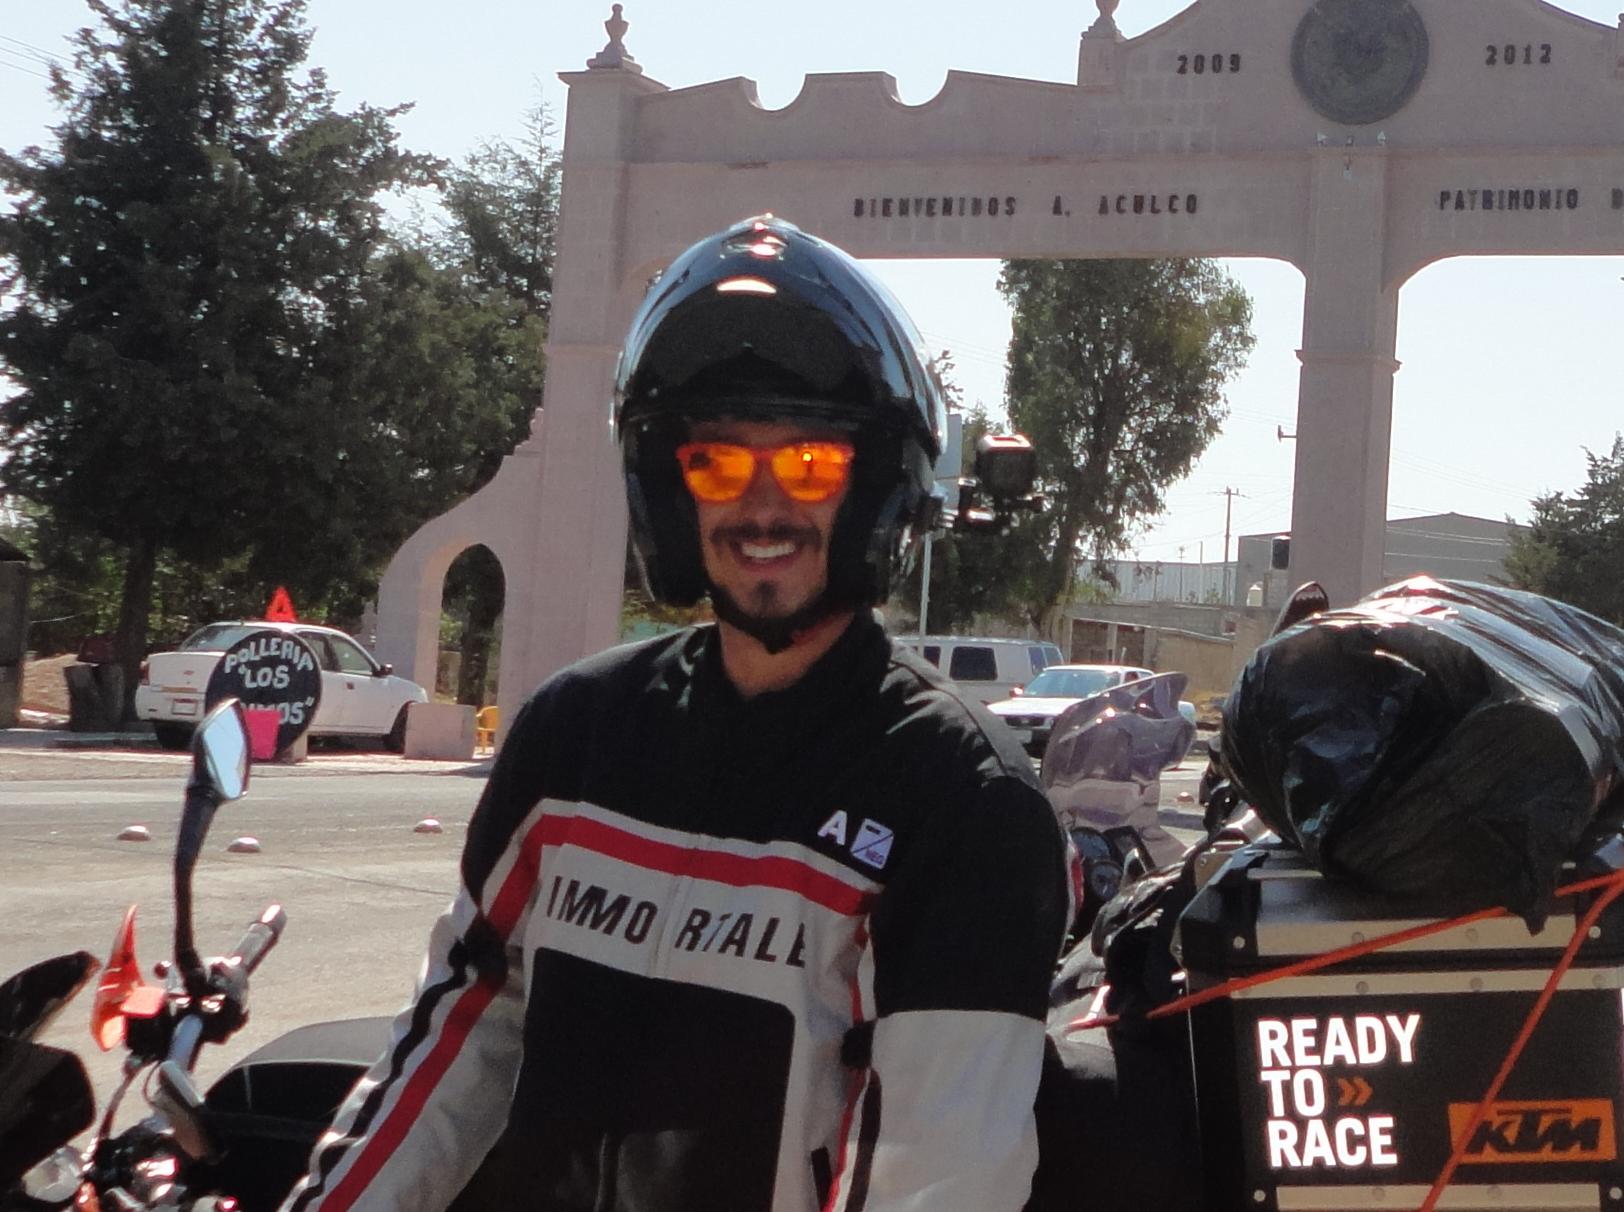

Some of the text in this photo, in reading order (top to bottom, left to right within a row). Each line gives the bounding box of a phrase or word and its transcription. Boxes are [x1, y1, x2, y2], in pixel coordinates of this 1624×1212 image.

[1176, 53, 1241, 75] 2009
[1485, 44, 1552, 66] 2012
[853, 196, 1016, 218] BIENVENIDOS
[1098, 193, 1198, 215] ACULCO
[1439, 188, 1579, 211] PATRIMONIO
[224, 637, 314, 674] POLLERIA
[1257, 1013, 1421, 1068] READY
[1260, 1068, 1327, 1118] TO
[1267, 1116, 1399, 1168] RACE
[1465, 1106, 1603, 1155] KTM
